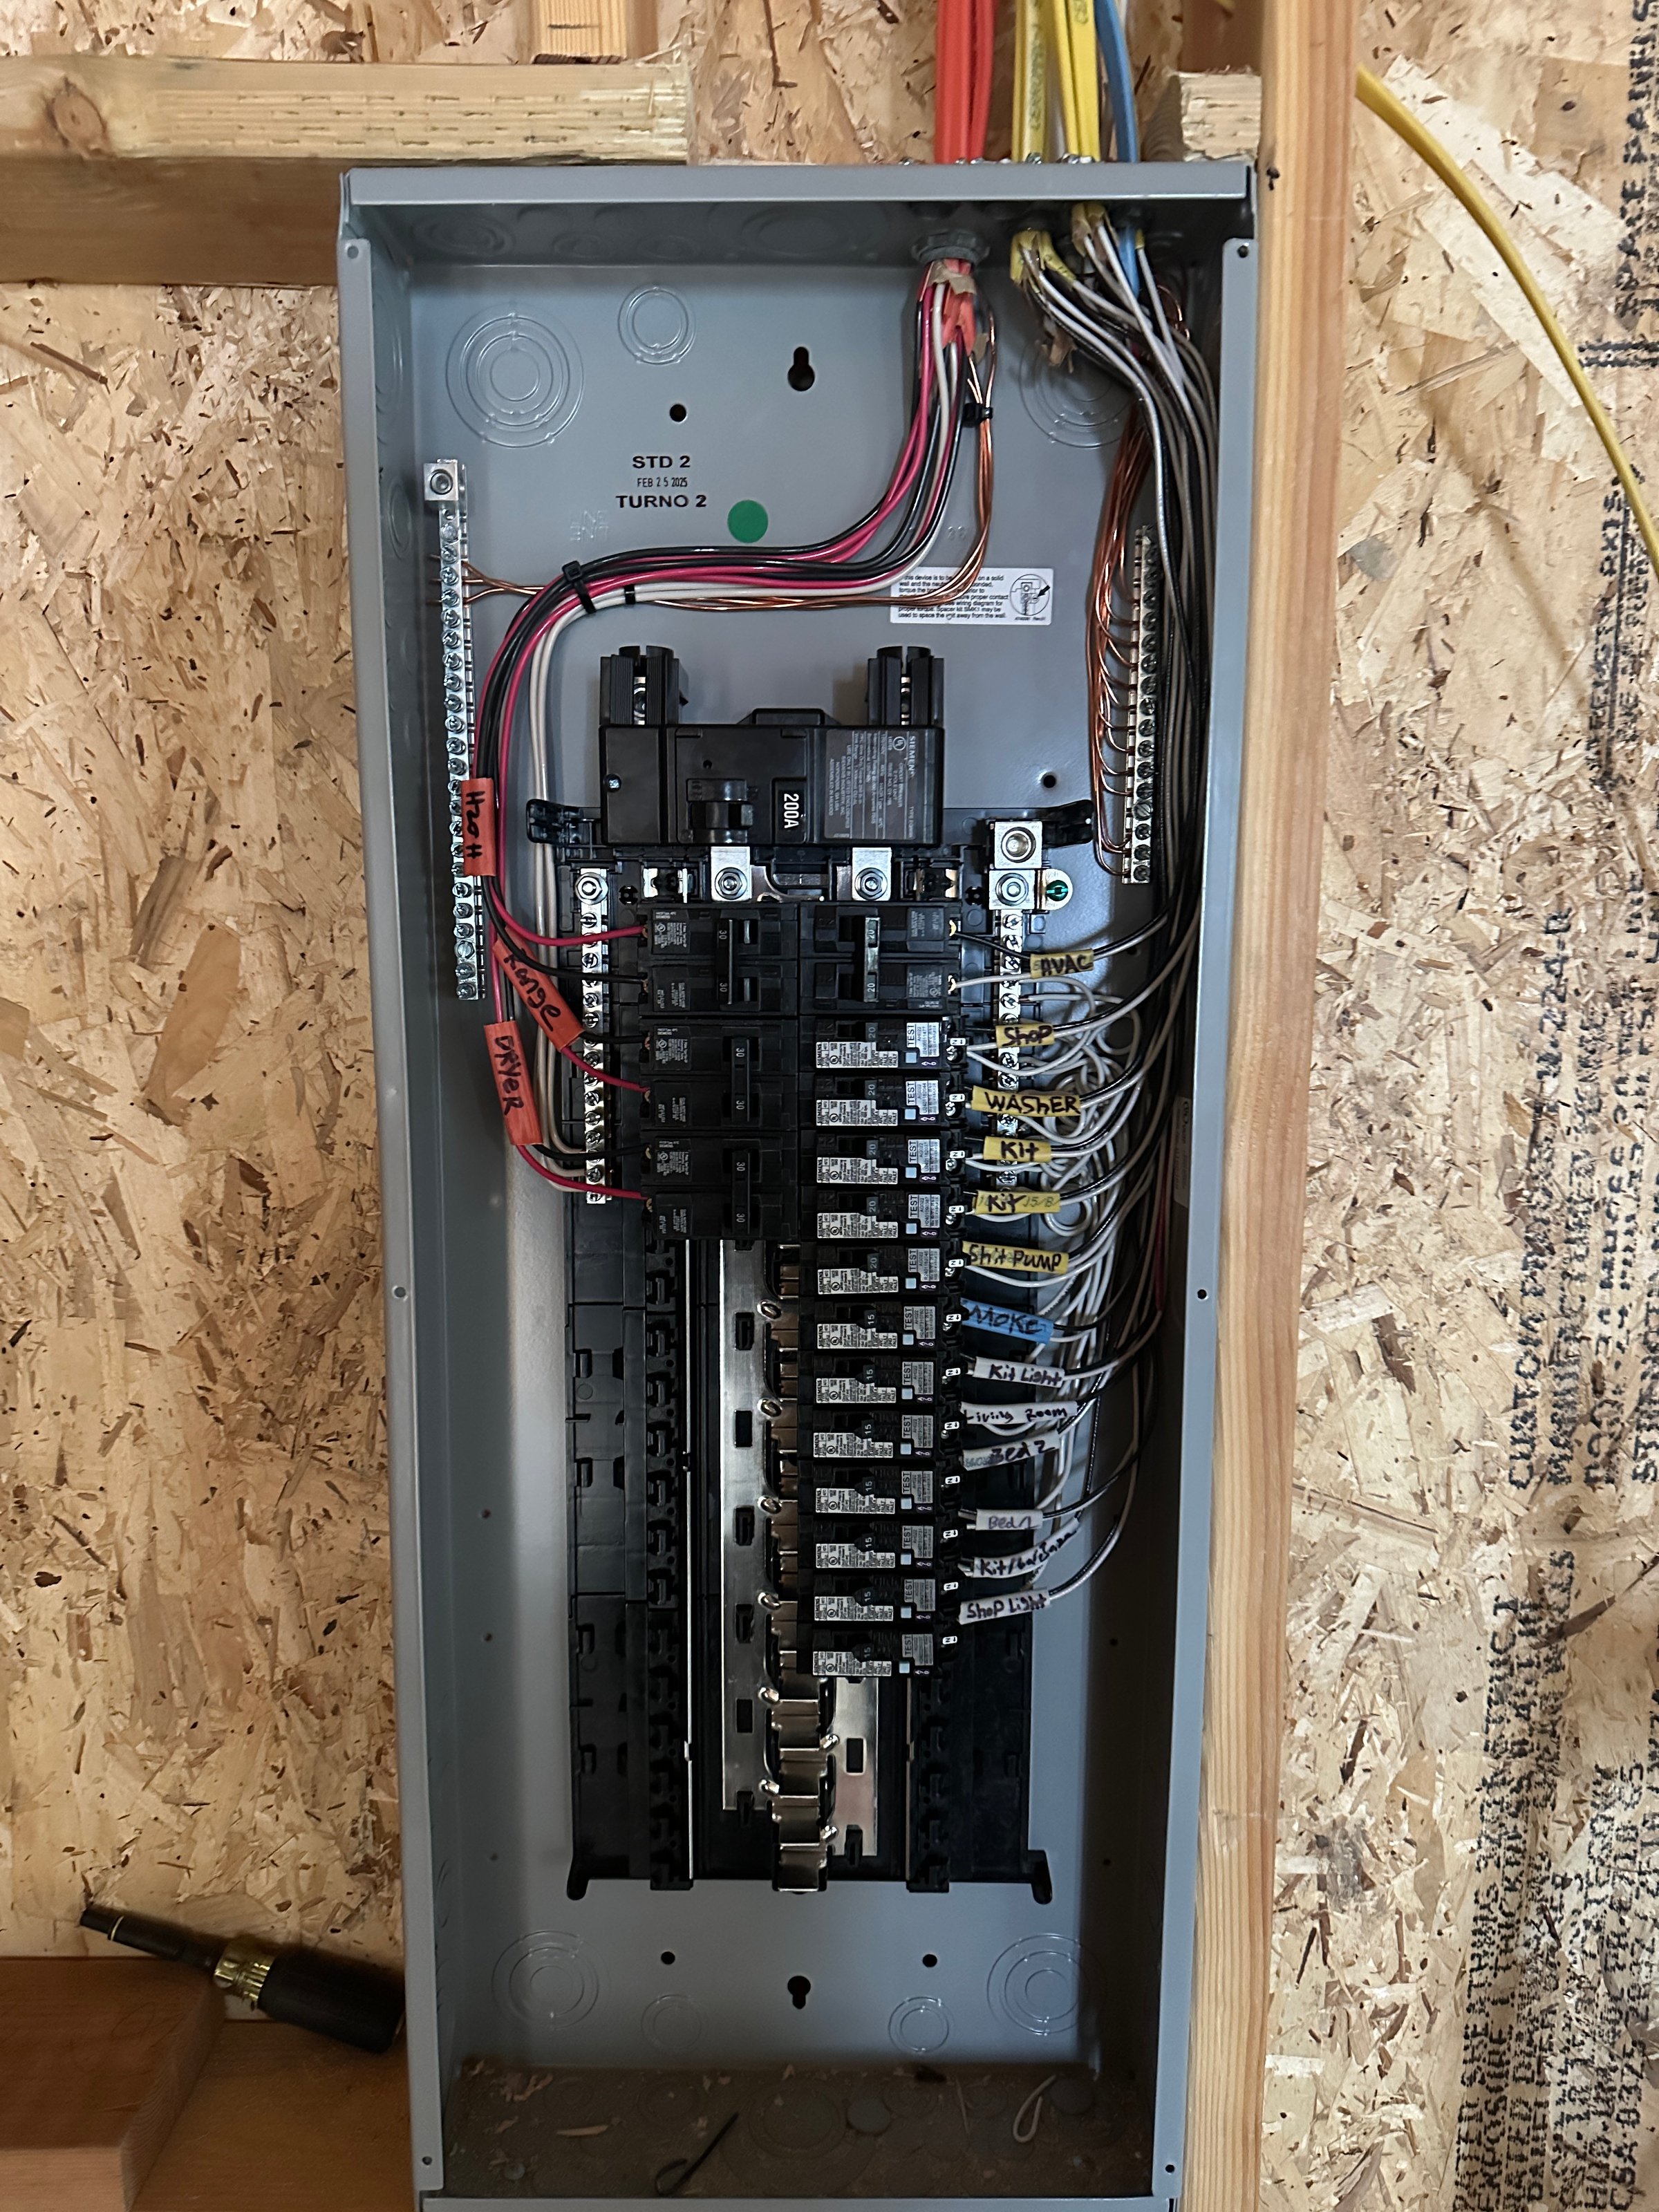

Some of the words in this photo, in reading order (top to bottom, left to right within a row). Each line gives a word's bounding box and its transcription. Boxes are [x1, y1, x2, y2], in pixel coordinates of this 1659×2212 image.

[632, 456, 673, 469] STD
[679, 455, 691, 468] 2
[637, 478, 653, 487] FEB
[671, 477, 688, 487] 2025
[616, 494, 689, 509] TURNO
[695, 494, 707, 507] 2
[784, 793, 799, 829] 200A
[719, 930, 727, 940] 30
[867, 930, 875, 939] 20
[720, 982, 728, 993] 30
[867, 983, 875, 993] 20
[870, 1027, 874, 1038] 20
[736, 1047, 744, 1058] 30
[869, 1085, 874, 1096] 20
[736, 1100, 744, 1110] 30
[870, 1144, 876, 1155] 20
[737, 1161, 745, 1172] 30
[870, 1201, 876, 1212] 20
[736, 1212, 745, 1224] 30
[871, 1258, 877, 1268] 20
[868, 1315, 874, 1324] 15
[867, 1369, 872, 1380] 15
[1508, 1313, 1547, 1490] CUSTOM
[865, 1424, 871, 1434] 15
[1034, 1439, 1056, 1453] 2
[866, 1481, 872, 1491] 15
[866, 1537, 872, 1548] 15
[865, 1591, 870, 1602] 15
[864, 1647, 870, 1658] 15
